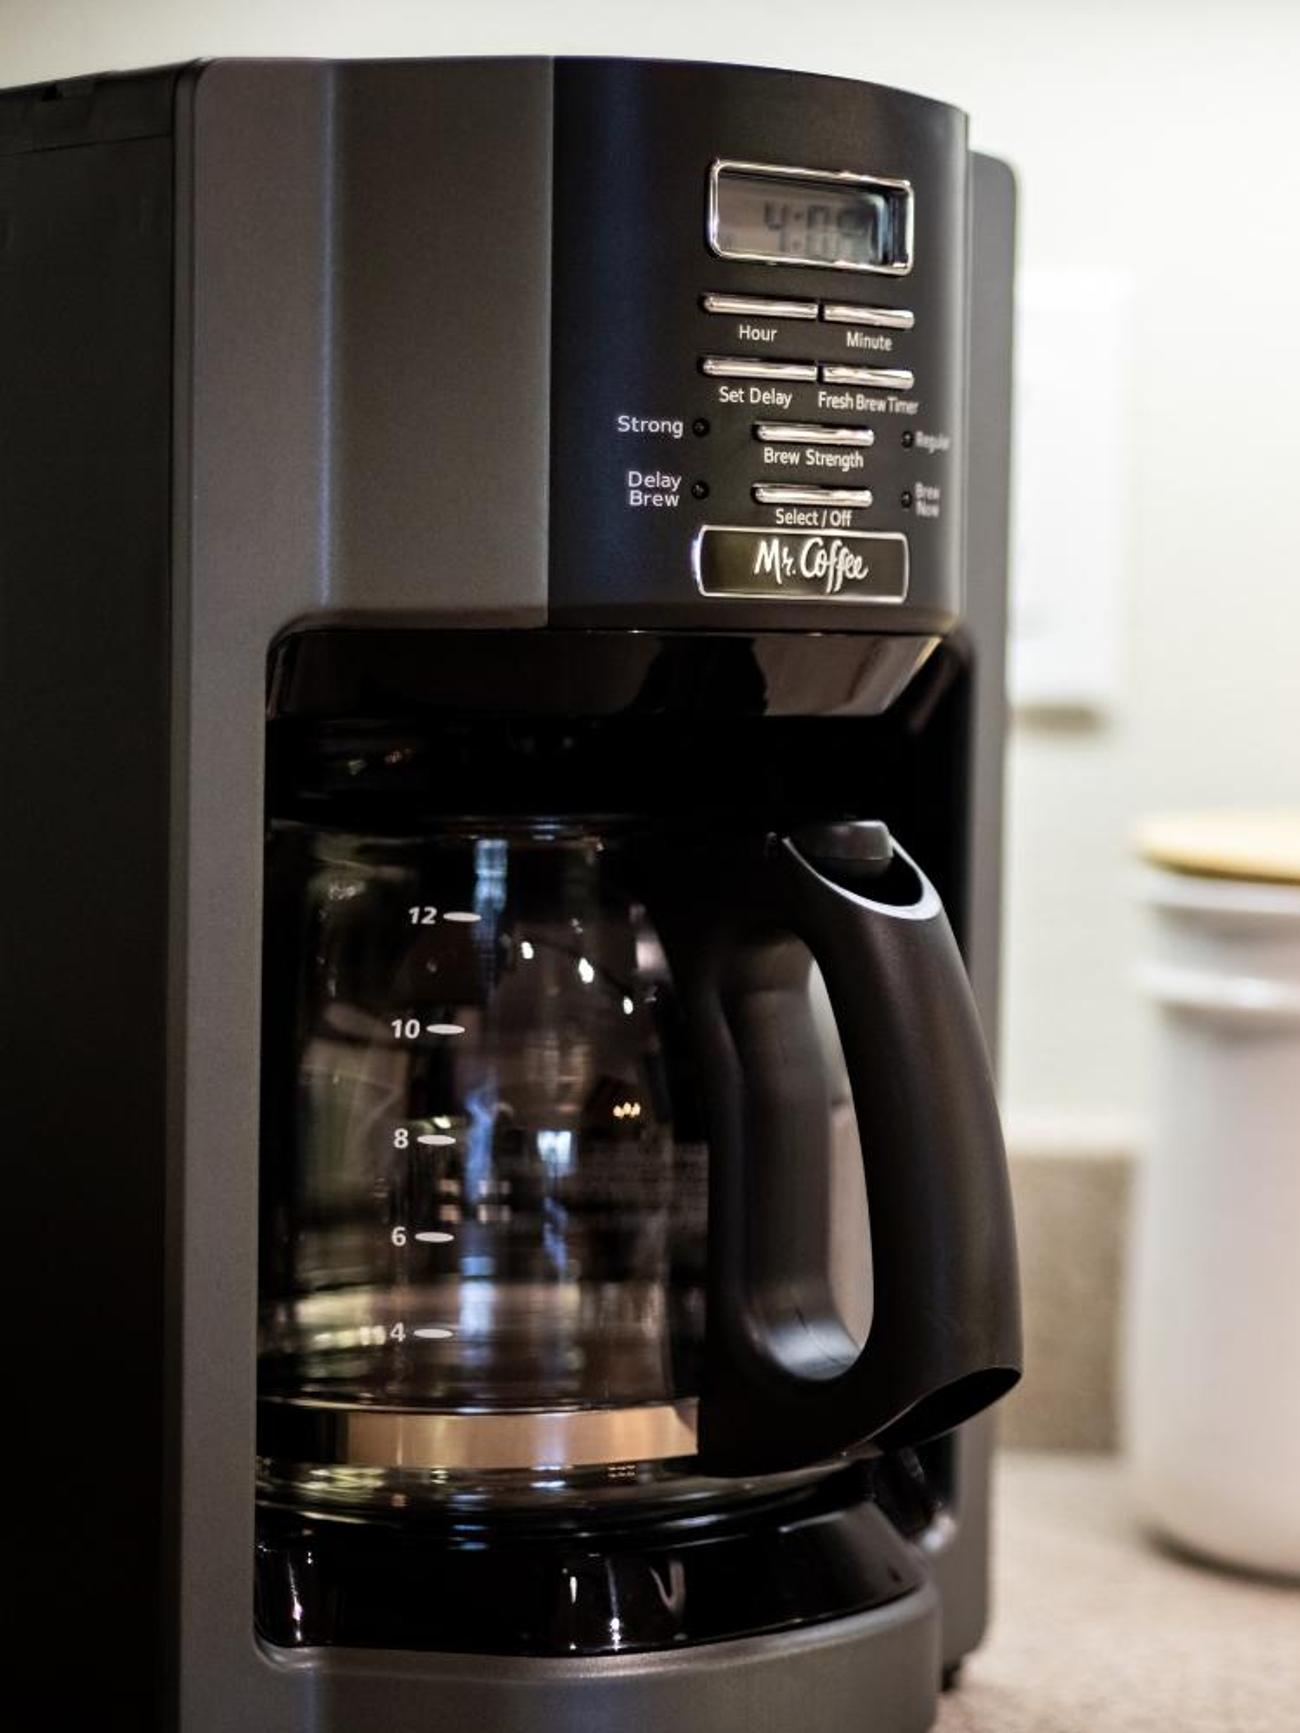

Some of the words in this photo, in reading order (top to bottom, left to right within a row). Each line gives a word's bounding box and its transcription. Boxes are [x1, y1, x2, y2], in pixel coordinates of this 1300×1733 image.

[739, 325, 777, 342] Hour
[846, 331, 892, 350] Minute
[719, 386, 744, 403] Set
[750, 388, 792, 408] Delay
[818, 391, 853, 408] Fresh
[856, 395, 886, 411] Brew
[887, 397, 919, 414] Timer
[617, 416, 684, 439] Strong
[764, 447, 800, 465] Brew
[805, 449, 864, 472] Strength
[628, 471, 682, 491] Delay
[629, 491, 680, 507] Brew
[775, 509, 818, 527] Select
[830, 510, 852, 528] Off
[754, 538, 796, 585] Mr.
[800, 536, 868, 593] Coffee
[408, 907, 438, 925] 12
[391, 1019, 421, 1039] 10
[393, 1129, 409, 1149] 8
[391, 1226, 407, 1246] 6
[390, 1322, 406, 1342] 4
